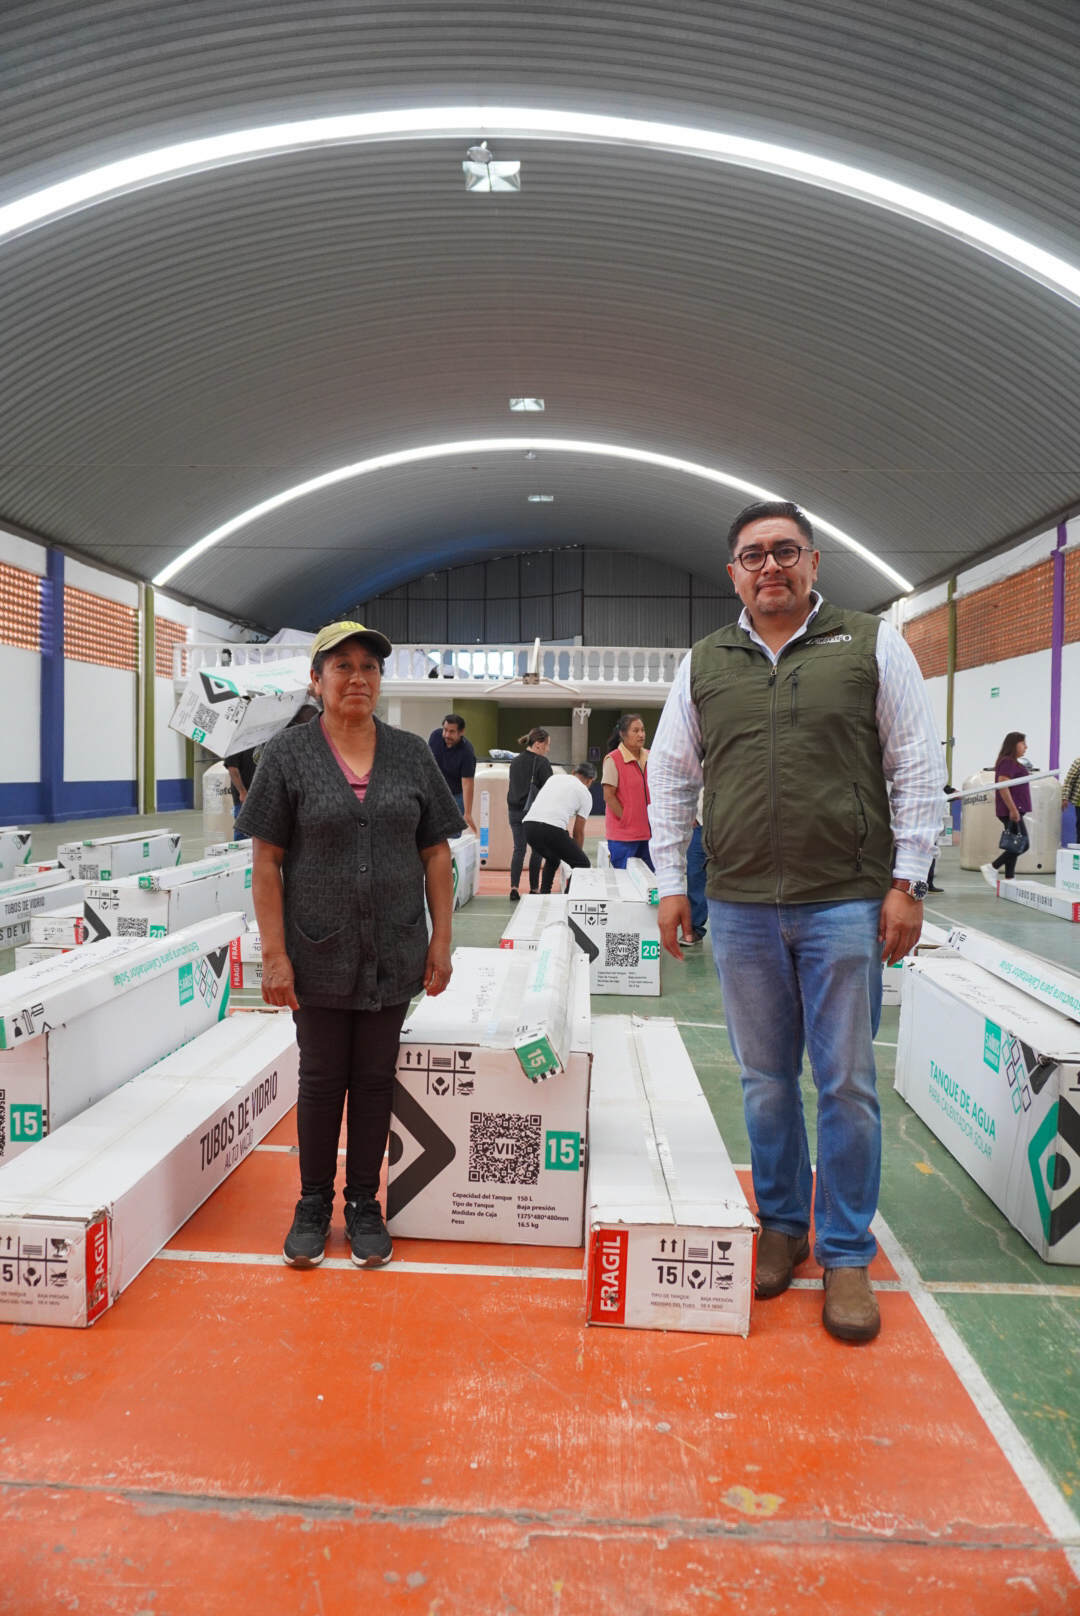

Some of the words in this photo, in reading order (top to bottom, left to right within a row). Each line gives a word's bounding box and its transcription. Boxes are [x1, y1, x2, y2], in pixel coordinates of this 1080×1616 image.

[5, 902, 21, 915] TUBOS
[22, 900, 29, 911] DE
[30, 896, 45, 909] VIDRIO
[1016, 887, 1030, 900] TUBOS
[1030, 892, 1036, 902] DE
[1036, 894, 1053, 907] VIDRIO
[7, 926, 17, 938] DE
[160, 949, 173, 963] para
[173, 941, 200, 957] Estructura
[643, 945, 657, 957] 20
[130, 958, 161, 978] Calentador
[233, 962, 241, 986] FRAGIL
[998, 960, 1013, 974] Solar
[113, 971, 130, 986] Solar
[1011, 966, 1040, 989] Calentador
[1040, 982, 1056, 995] para
[527, 1048, 547, 1067] 15
[930, 1060, 959, 1103] TANQUE
[960, 1089, 970, 1115] DE
[971, 1102, 996, 1141] AGUA
[12, 1111, 38, 1135] 15
[200, 1110, 234, 1171] TUBOS
[238, 1096, 250, 1136] DE
[251, 1070, 278, 1120] VIDRIO
[928, 1084, 942, 1106] PARA
[941, 1095, 974, 1139] CALENTADOR
[973, 1131, 993, 1161] SOLAR
[224, 1144, 239, 1171] ALTO
[495, 1142, 514, 1155] VII
[548, 1138, 575, 1164] 15
[600, 1236, 621, 1312] FRAGIL
[657, 1265, 678, 1285] 15
